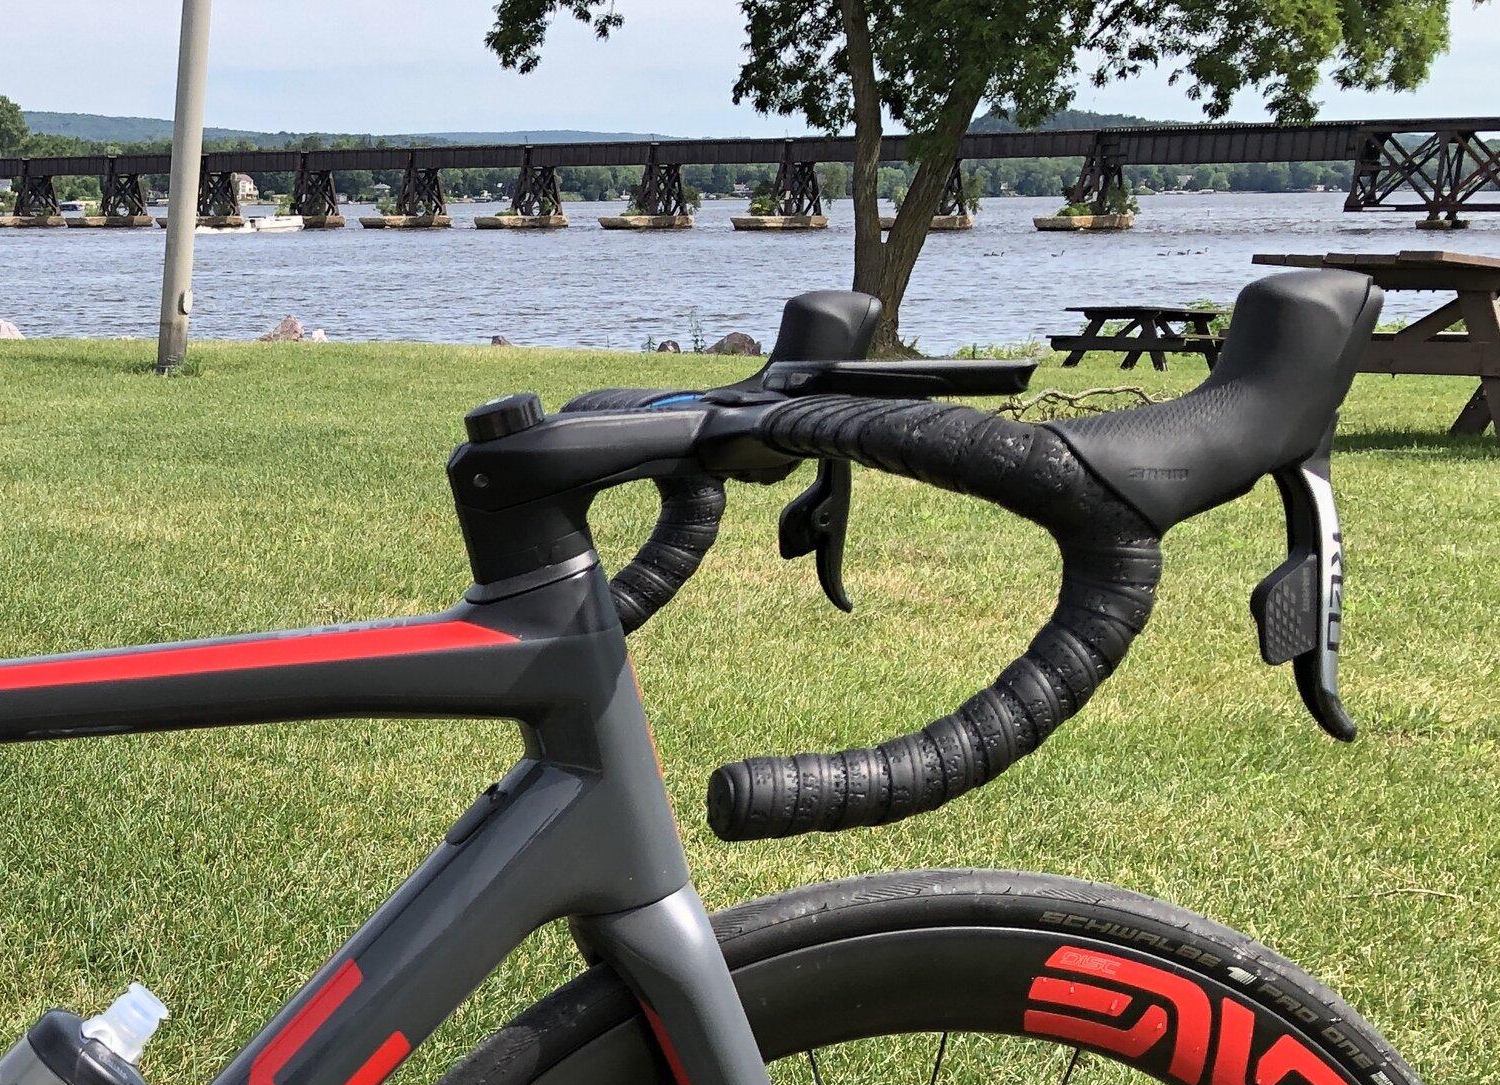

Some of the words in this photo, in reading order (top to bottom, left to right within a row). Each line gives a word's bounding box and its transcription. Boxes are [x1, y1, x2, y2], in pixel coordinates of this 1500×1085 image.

[1038, 910, 1222, 968] SCHWALBE
[1256, 981, 1320, 1024] PRO
[1320, 1025, 1376, 1070] ONE
[1060, 951, 1122, 976] DISC
